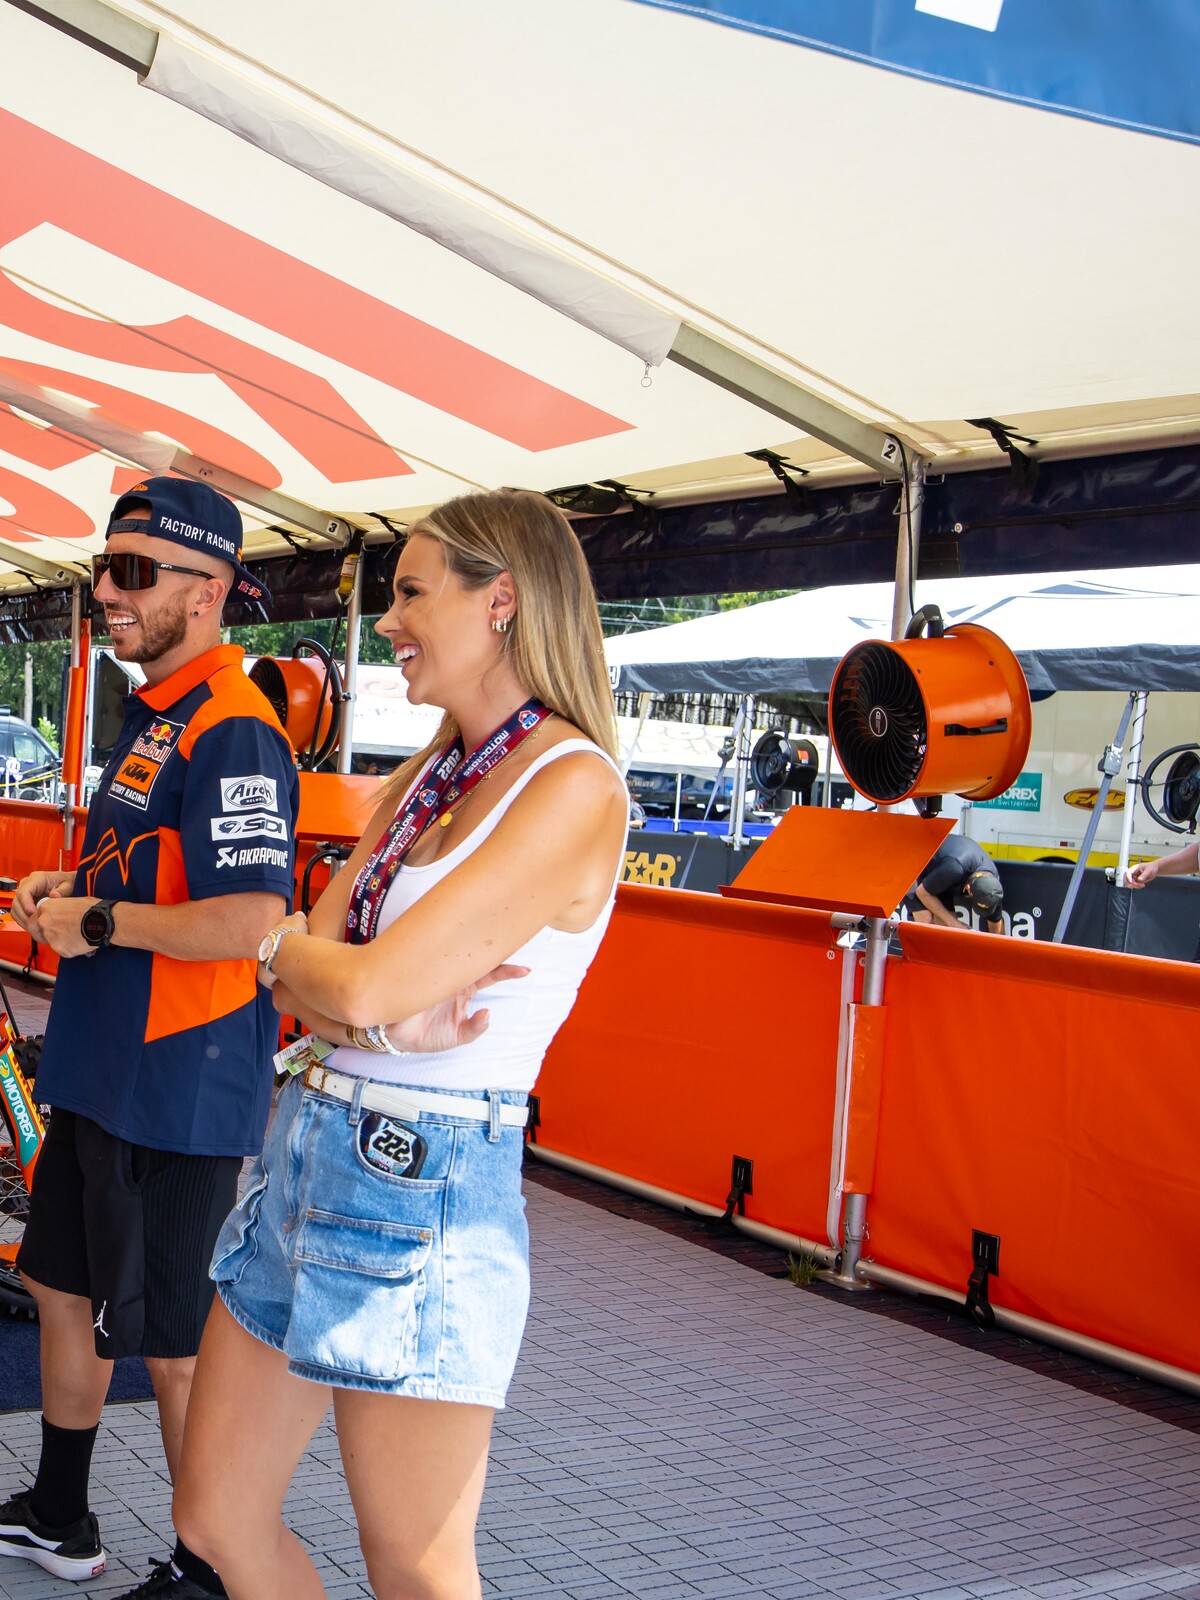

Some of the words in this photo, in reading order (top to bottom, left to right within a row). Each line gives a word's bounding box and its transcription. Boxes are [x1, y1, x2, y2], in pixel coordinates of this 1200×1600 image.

[883, 443, 896, 459] 2
[159, 516, 206, 541] FACTORY
[206, 531, 236, 555] RACING
[328, 522, 338, 533] 3
[57, 570, 65, 579] 4
[133, 738, 151, 757] Red
[146, 742, 171, 763] Bull
[436, 748, 462, 781] 2022
[463, 730, 509, 777] MOTOCROSS
[121, 762, 150, 783] KTM
[124, 787, 147, 805] RACING
[230, 783, 272, 801] Airoh
[380, 812, 414, 863] MOTOCROSS
[360, 899, 371, 936] 2022
[3, 1077, 37, 1143] MOTOREX
[372, 1129, 411, 1163] 222
